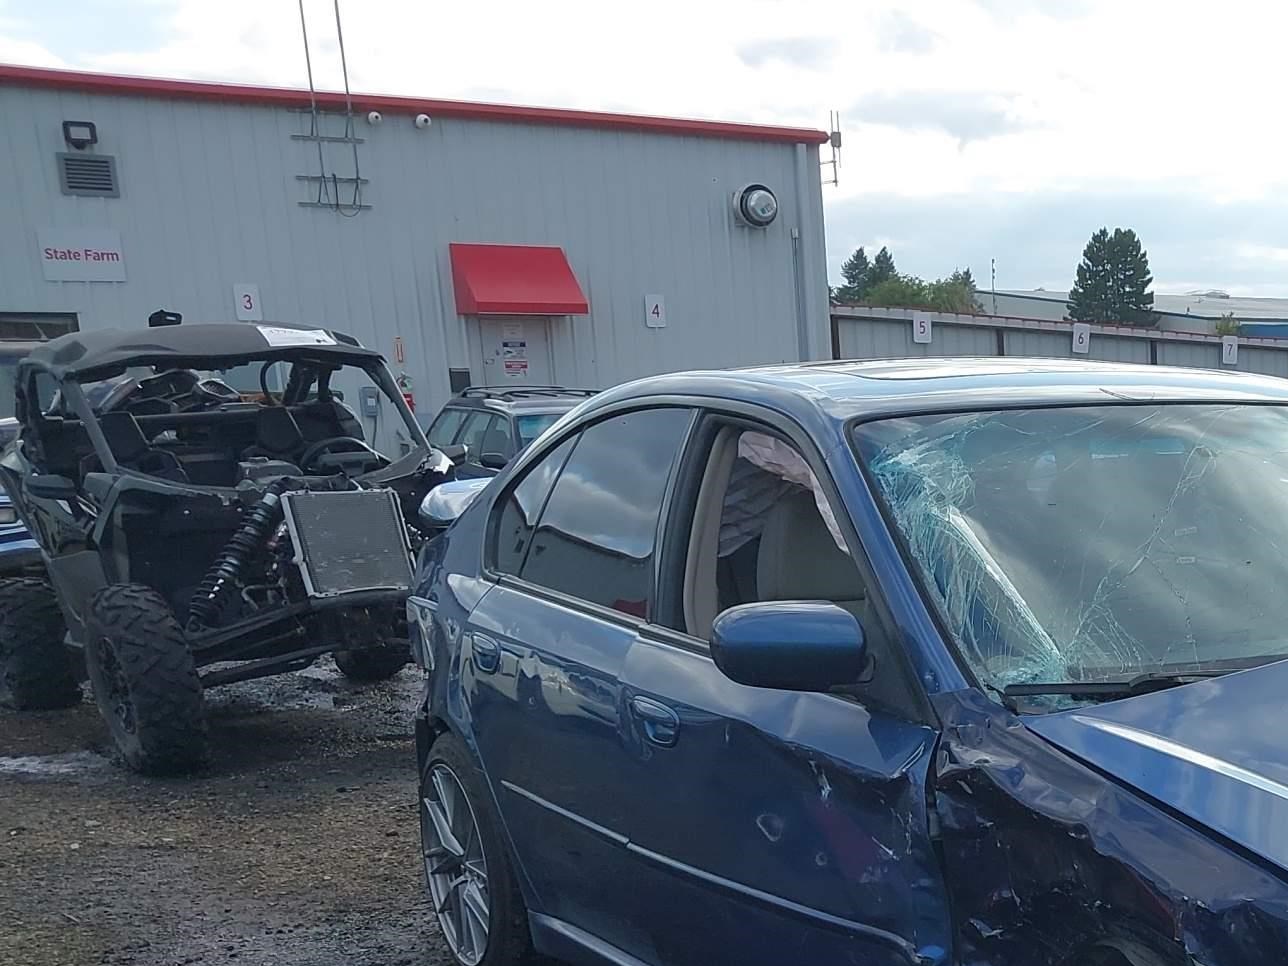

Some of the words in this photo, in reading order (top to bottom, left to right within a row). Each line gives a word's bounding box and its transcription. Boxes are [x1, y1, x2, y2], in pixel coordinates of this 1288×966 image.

[44, 248, 81, 261] State
[84, 249, 120, 262] Farm
[242, 294, 253, 310] 3
[651, 303, 660, 318] 4
[919, 320, 926, 335] 5
[1077, 332, 1084, 345] 6
[1227, 343, 1234, 357] 7
